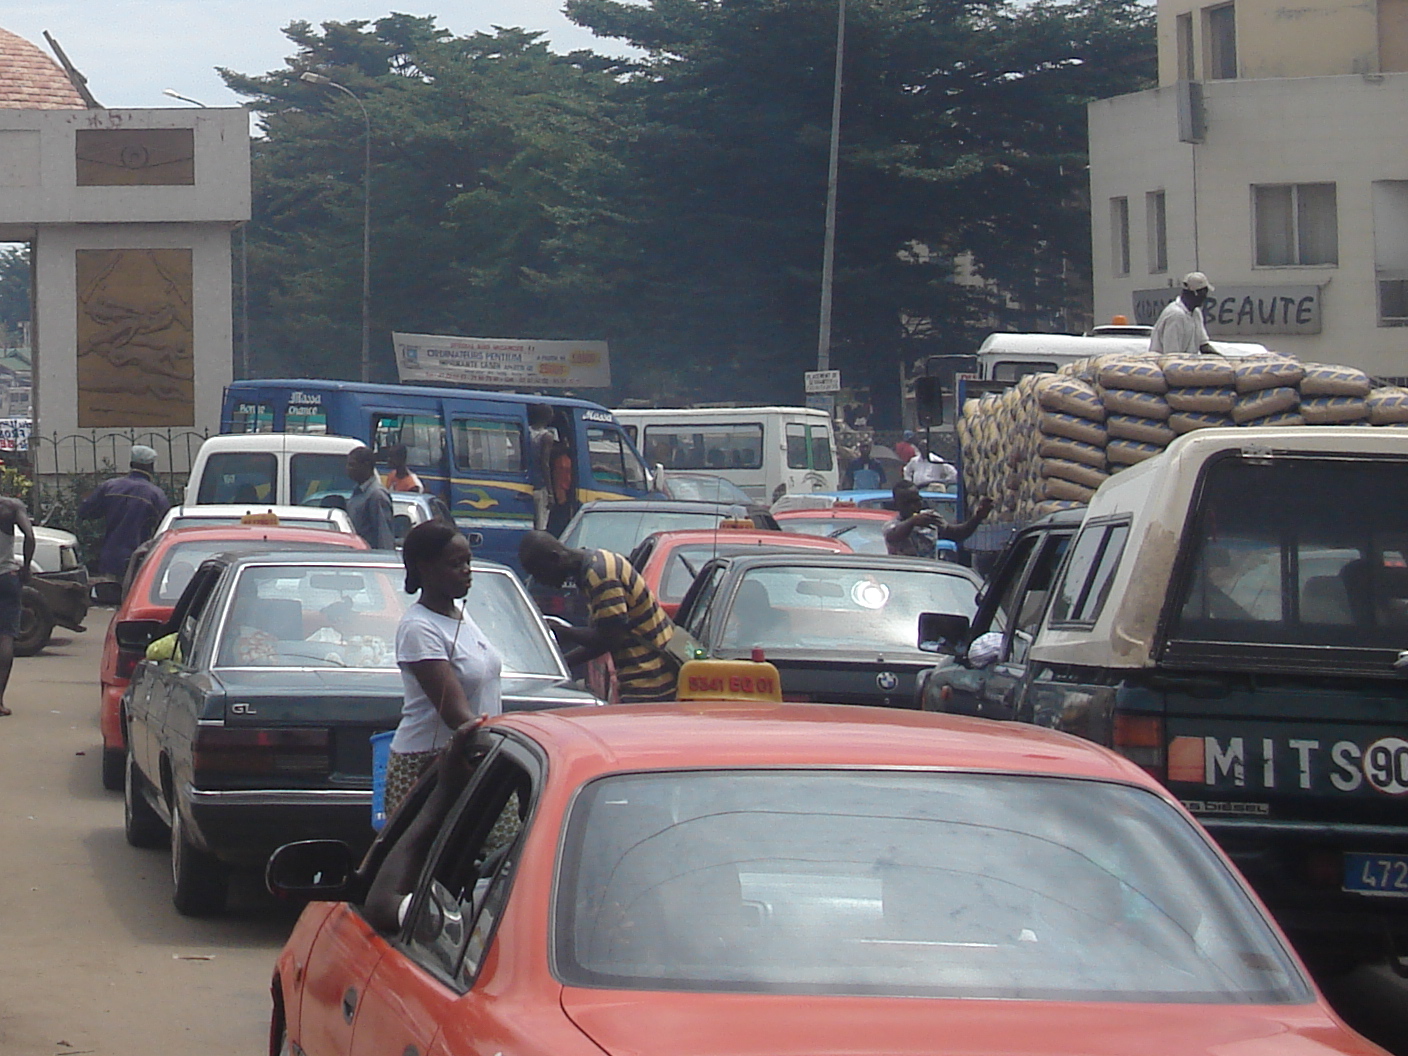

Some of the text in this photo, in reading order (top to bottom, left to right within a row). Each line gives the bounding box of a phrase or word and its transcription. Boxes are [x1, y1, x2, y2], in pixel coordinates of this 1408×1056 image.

[1203, 295, 1314, 326] BEAUTE
[232, 703, 257, 714] GL
[1204, 735, 1363, 792] MITS
